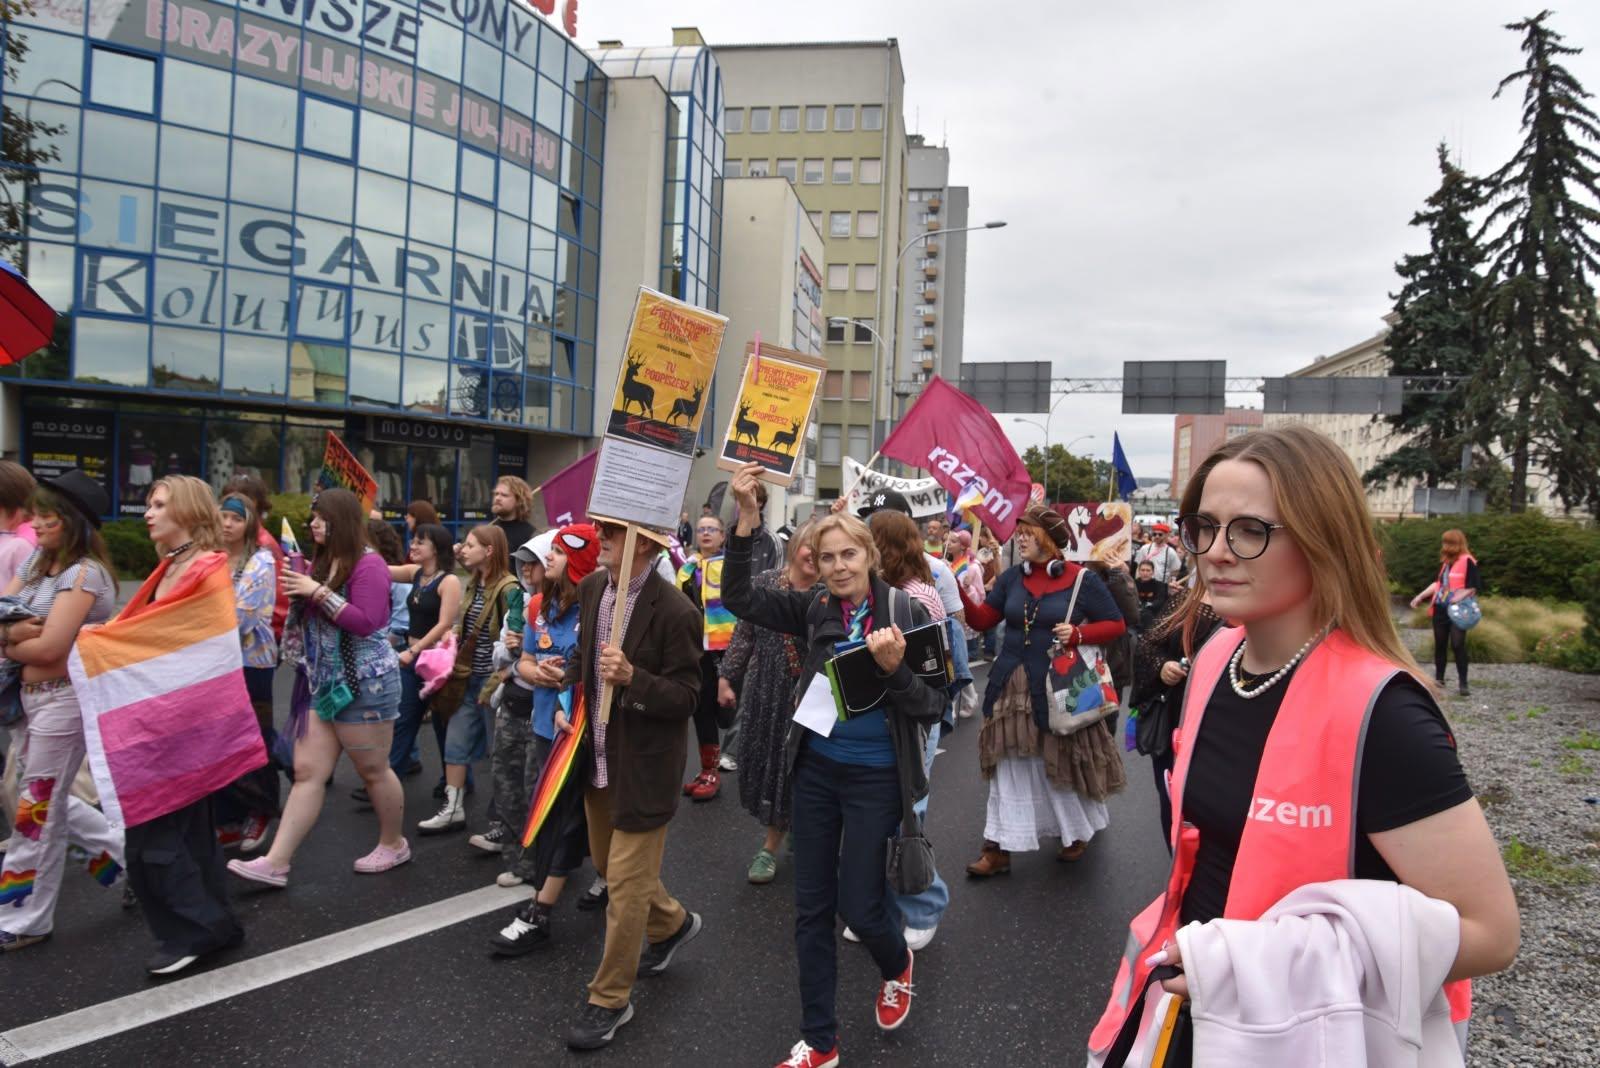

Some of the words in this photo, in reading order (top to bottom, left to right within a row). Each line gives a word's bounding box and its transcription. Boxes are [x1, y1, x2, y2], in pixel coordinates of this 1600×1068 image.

[145, 0, 436, 118] BRAZYLIJSKIE
[441, 92, 557, 170] JIU-JITSU
[28, 182, 552, 320] SIĘGARNIA
[644, 368, 690, 391] PODPISZESZ
[910, 492, 932, 507] NA
